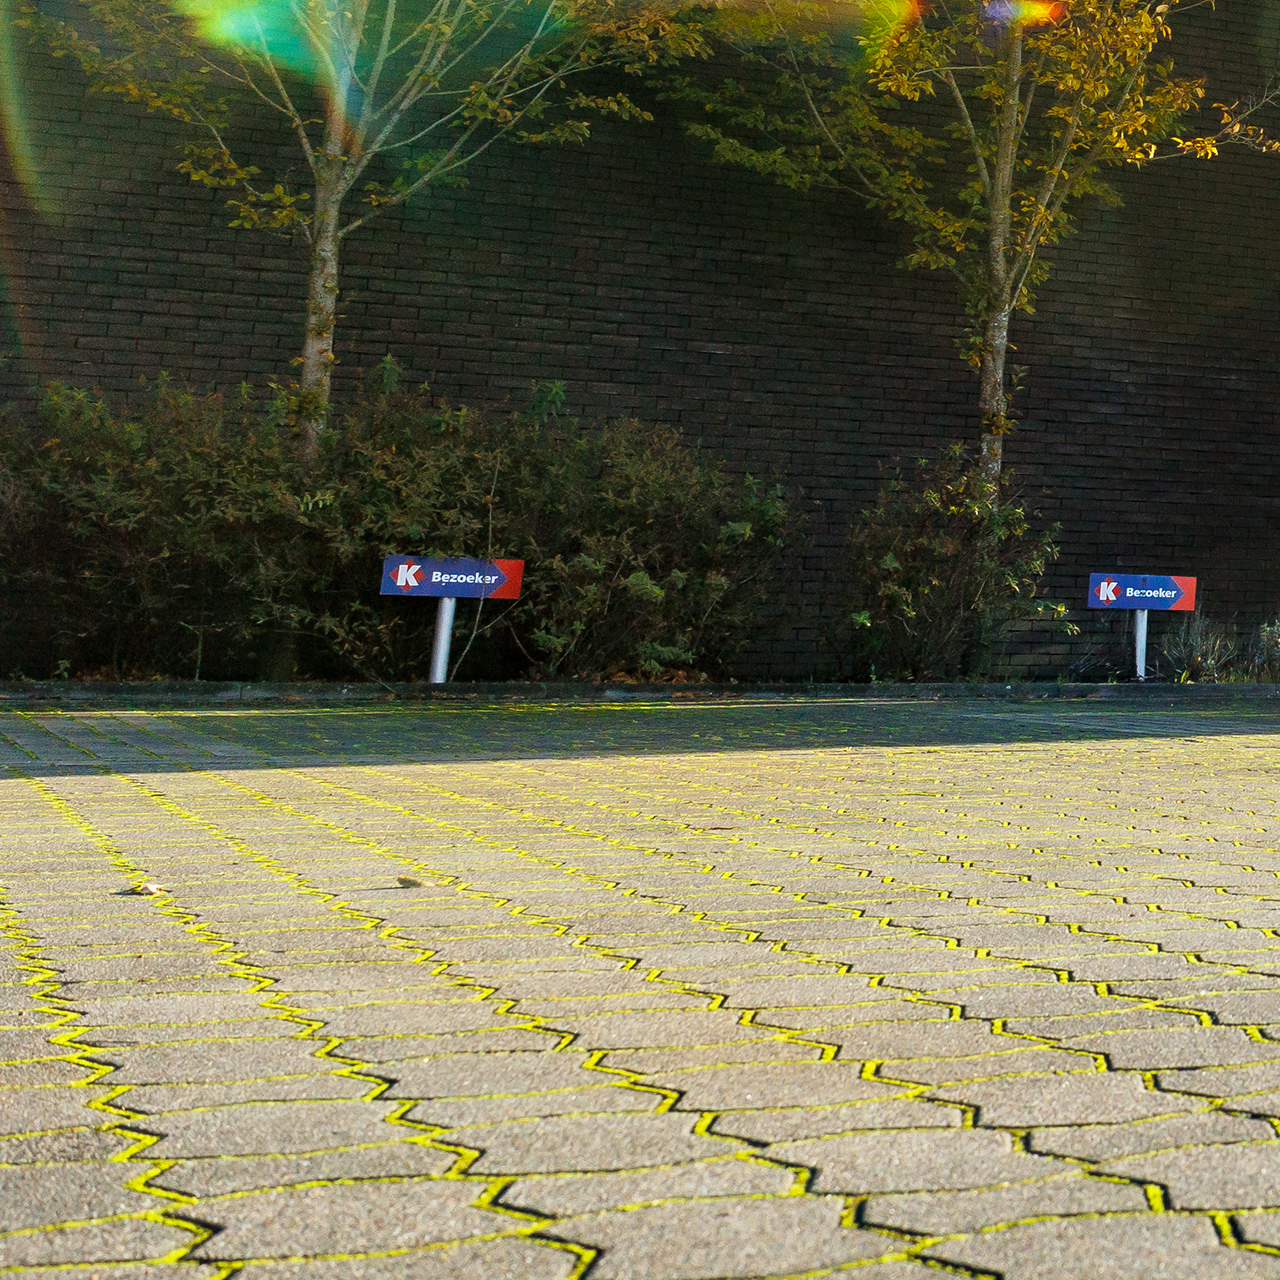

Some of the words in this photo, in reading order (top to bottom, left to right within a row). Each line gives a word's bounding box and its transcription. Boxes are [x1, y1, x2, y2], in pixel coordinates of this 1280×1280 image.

[396, 564, 421, 586] K
[431, 571, 499, 585] Bezoeker
[1099, 581, 1118, 601] K
[1126, 587, 1177, 598] Bezoeker
